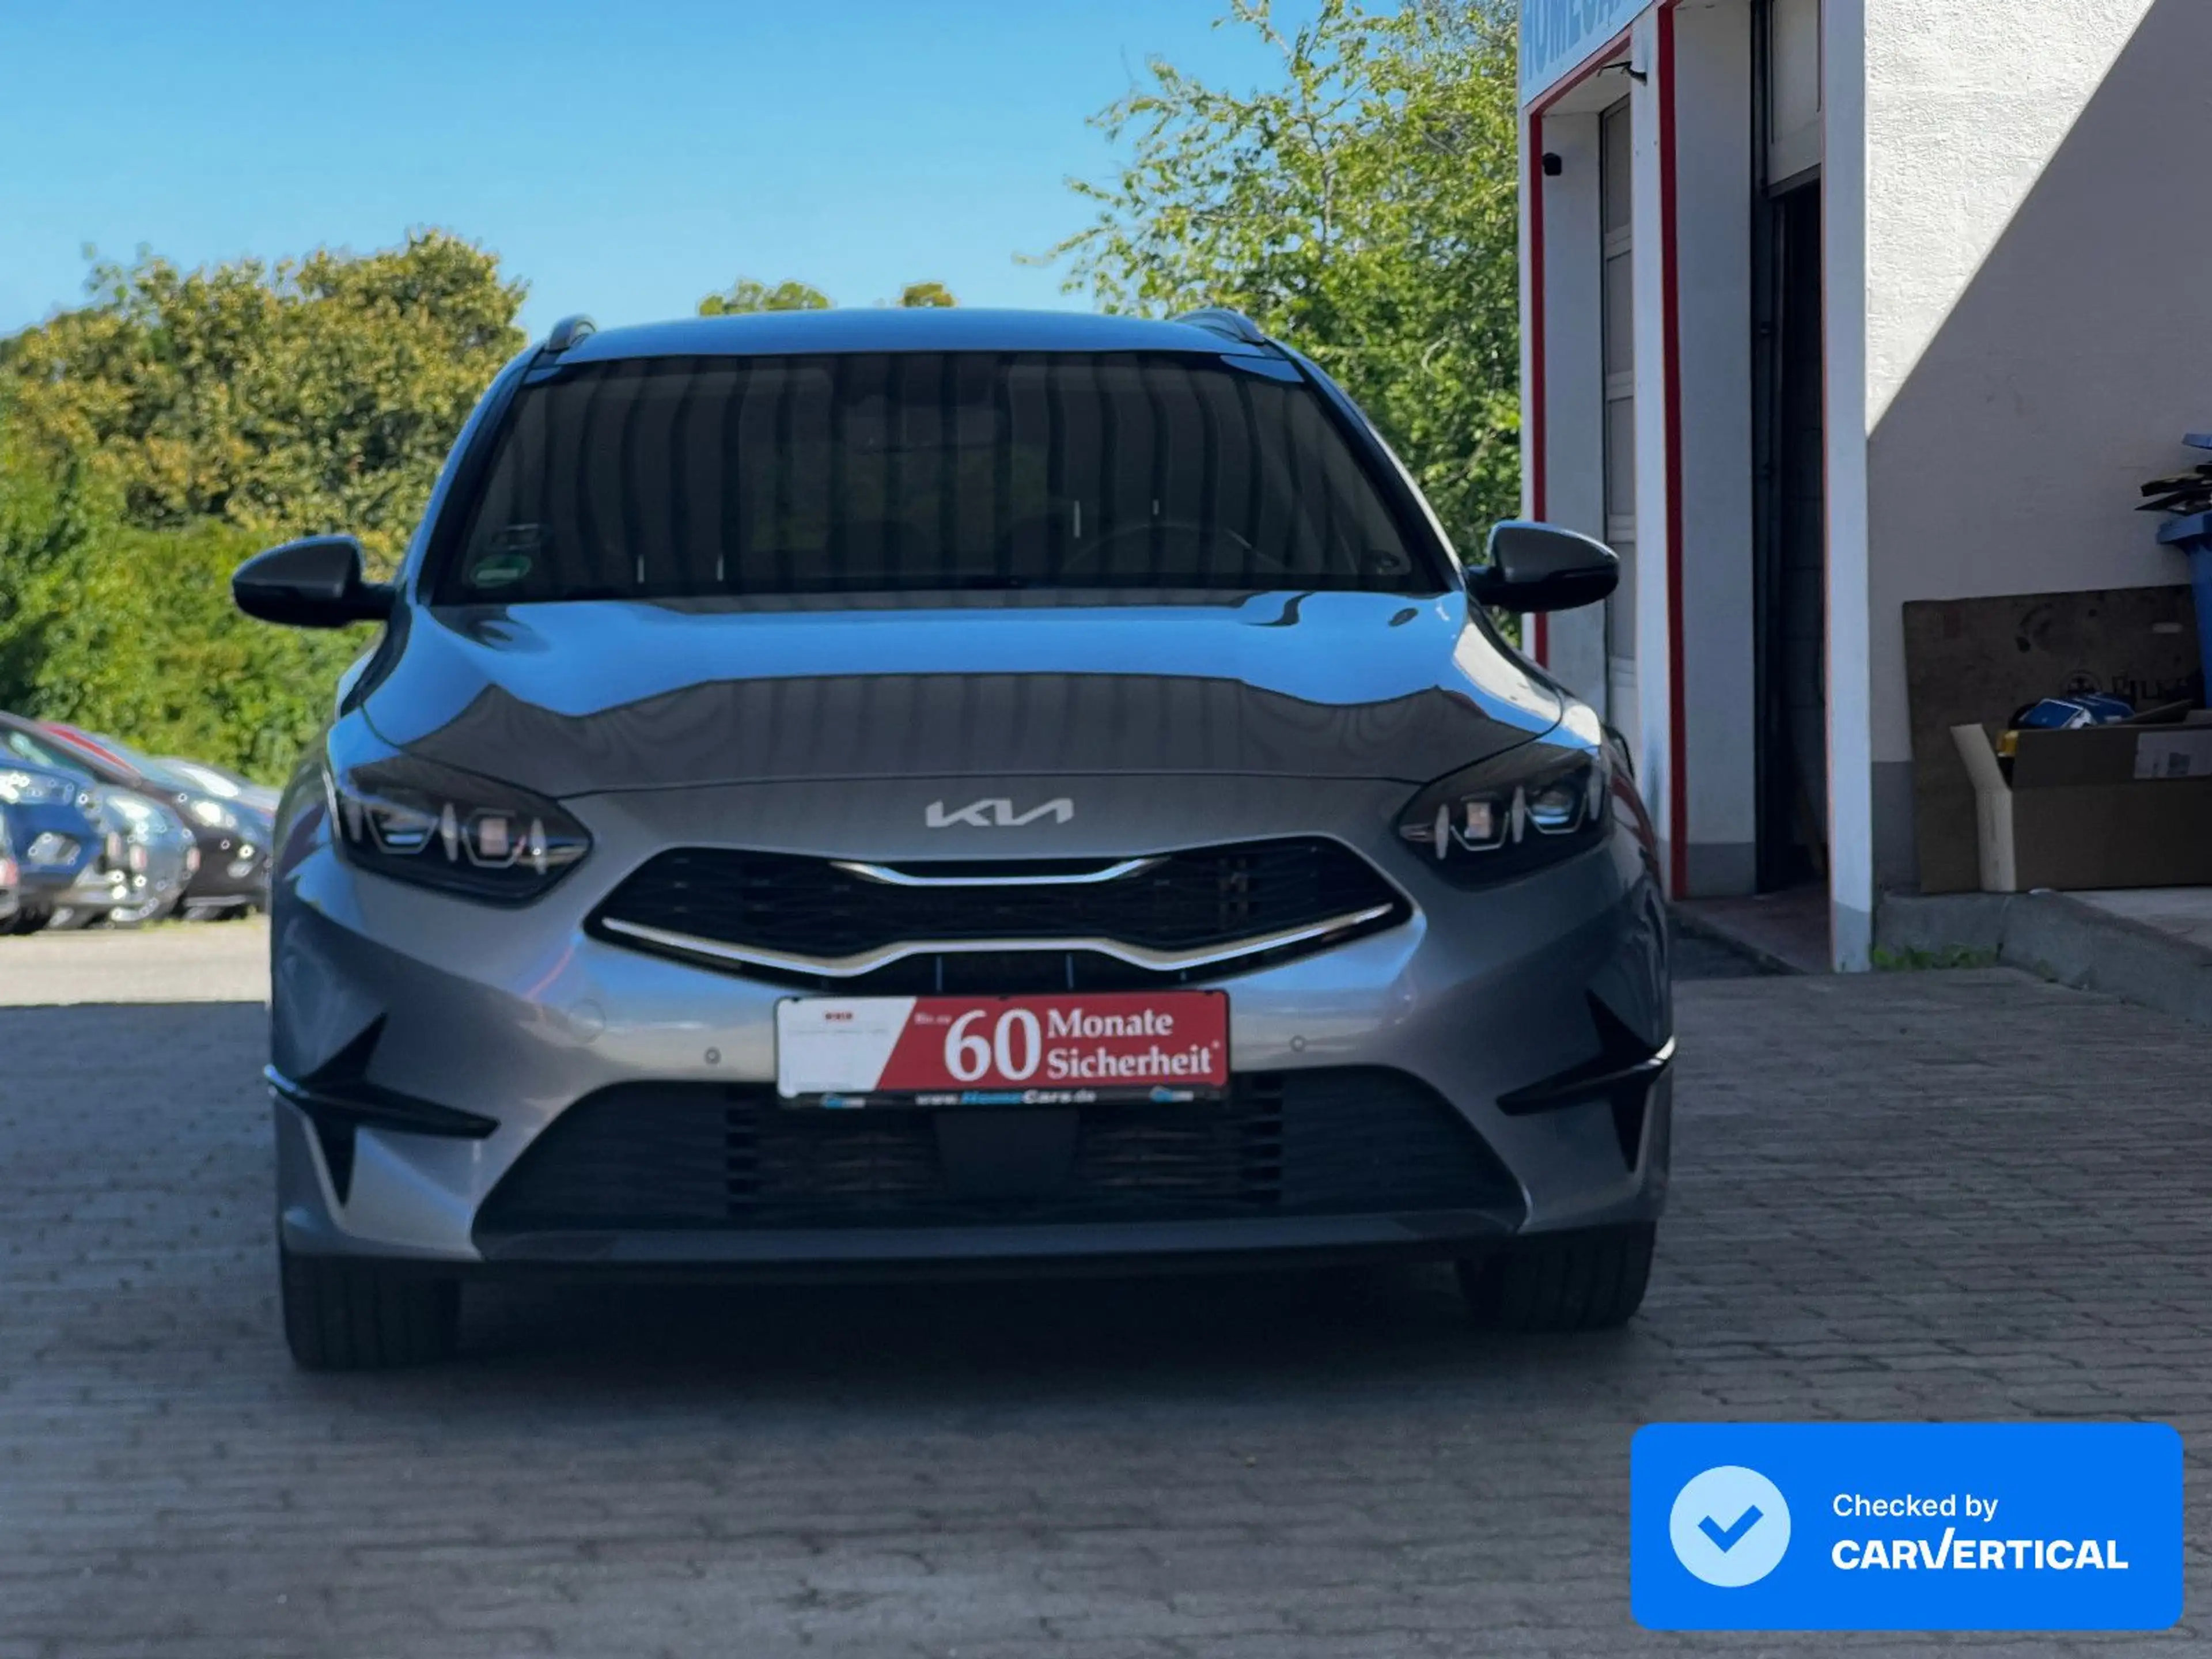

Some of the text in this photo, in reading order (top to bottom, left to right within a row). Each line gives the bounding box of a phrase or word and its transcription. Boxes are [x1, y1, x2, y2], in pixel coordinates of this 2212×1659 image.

[926, 798, 1074, 827] KIA
[1047, 1007, 1174, 1039] Monate
[945, 1009, 1041, 1081] 60
